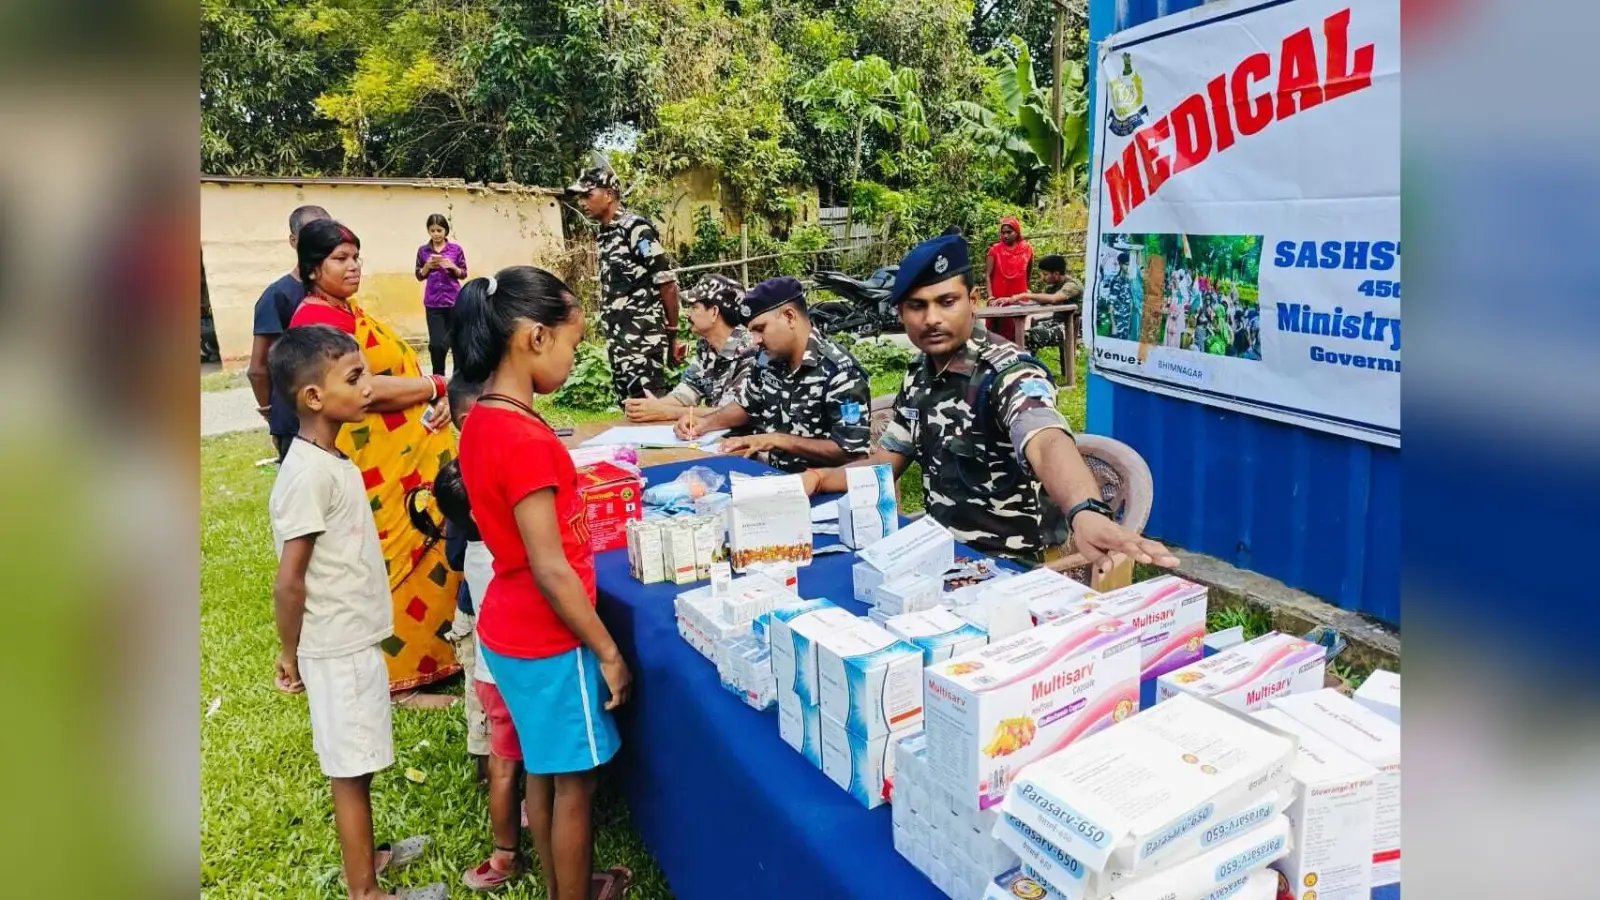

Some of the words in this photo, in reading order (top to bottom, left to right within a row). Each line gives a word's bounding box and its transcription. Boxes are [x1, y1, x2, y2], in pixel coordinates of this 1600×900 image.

[1104, 8, 1375, 227] MEDICAL
[1273, 240, 1400, 271] SASHS
[1276, 302, 1400, 351] Ministry
[1157, 361, 1203, 380] BHIMNAGAR
[1132, 607, 1176, 628] Multisarv
[928, 678, 967, 707] Multisarv
[1031, 662, 1094, 702] Multisarv
[1246, 677, 1292, 705] Multisarv
